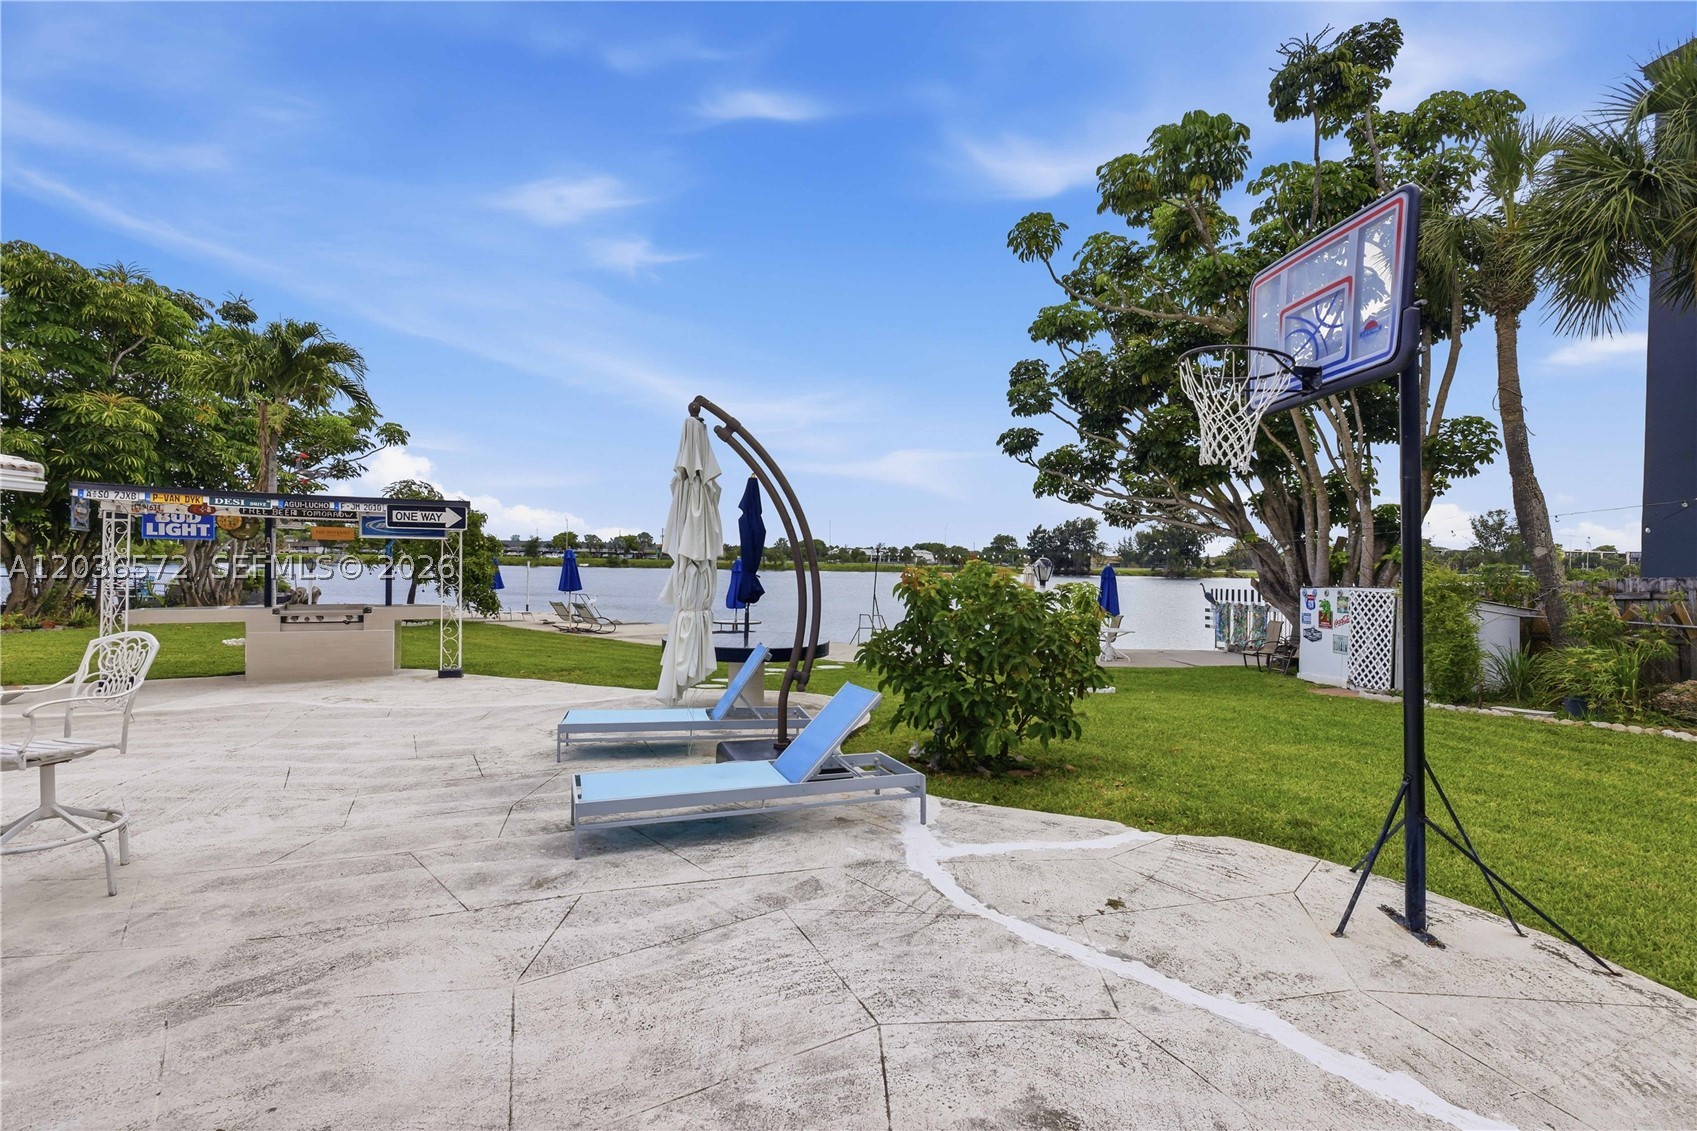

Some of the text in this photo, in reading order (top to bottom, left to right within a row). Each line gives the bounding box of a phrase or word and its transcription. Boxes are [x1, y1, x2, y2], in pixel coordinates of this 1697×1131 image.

[184, 495, 202, 504] DYK
[214, 498, 245, 506] DESI
[284, 501, 330, 510] AGUI-LUCHO
[363, 504, 382, 512] 2010
[302, 509, 354, 518] TOMORROW
[395, 511, 443, 522] ONE WAY
